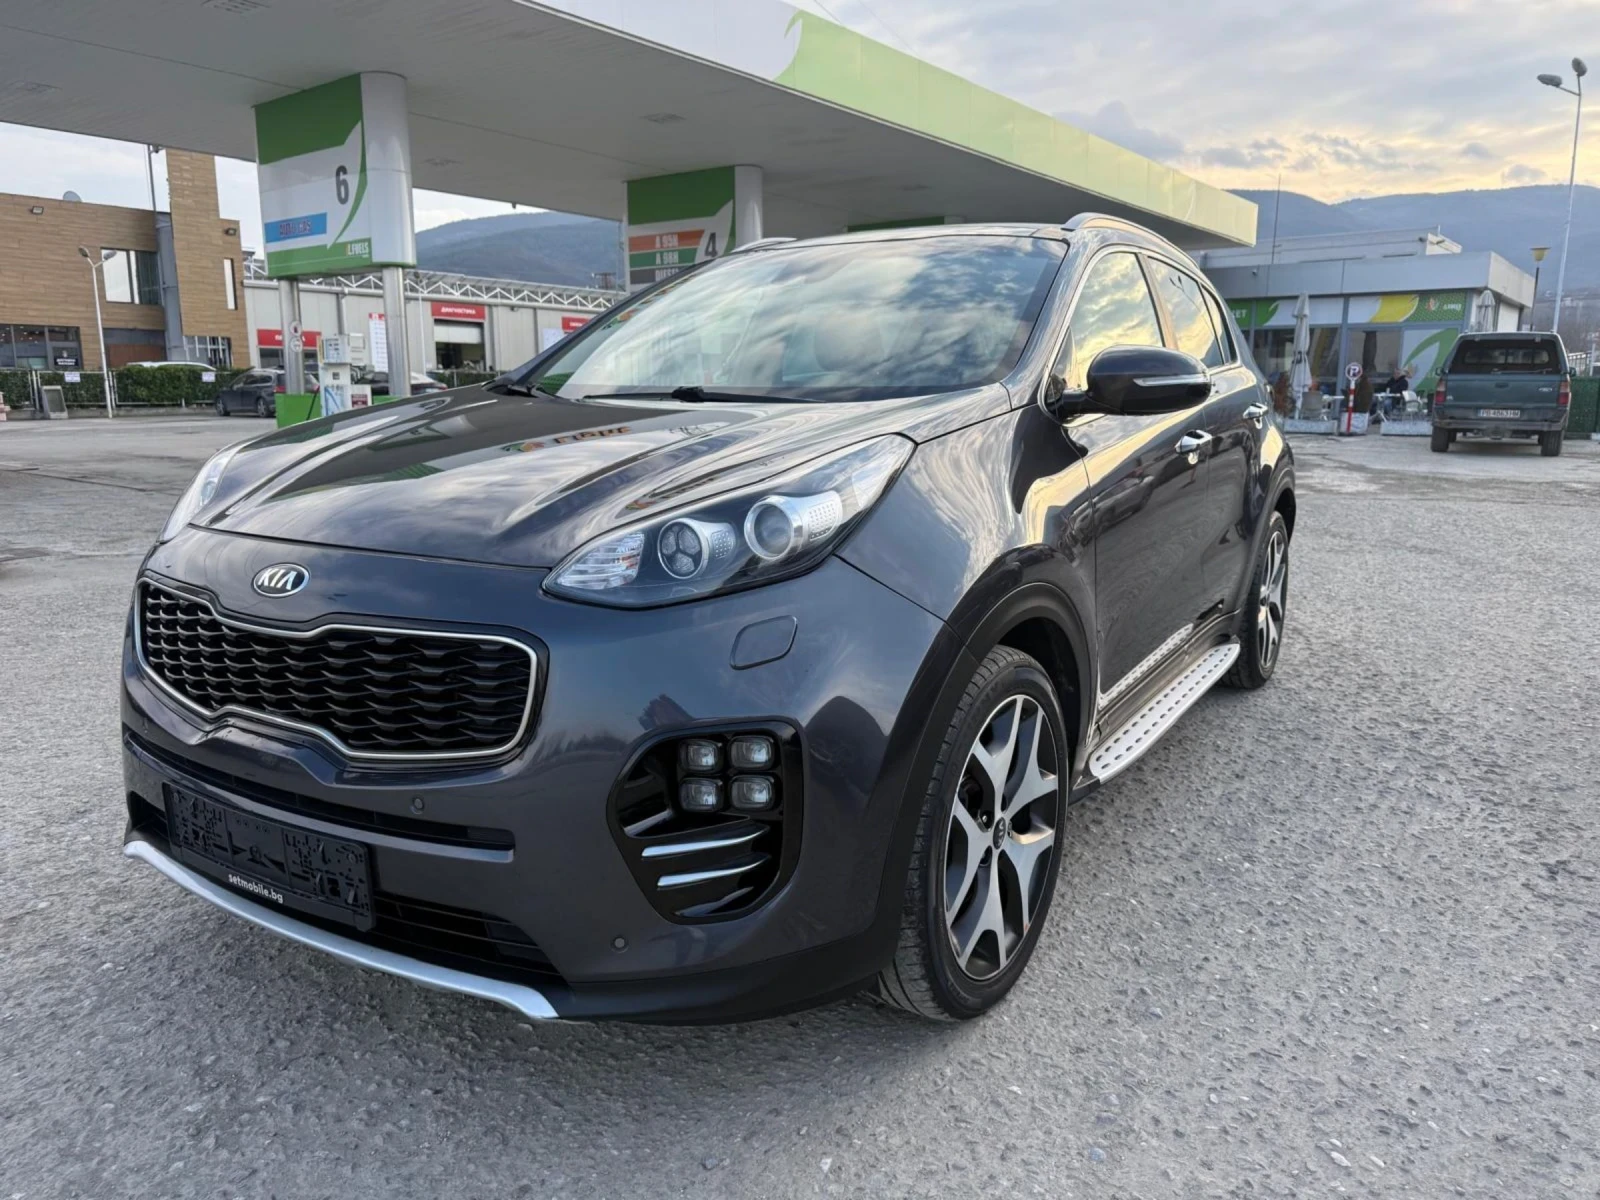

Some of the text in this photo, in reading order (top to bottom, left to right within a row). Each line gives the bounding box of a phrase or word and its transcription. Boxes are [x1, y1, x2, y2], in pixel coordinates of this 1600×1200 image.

[335, 165, 349, 205] 6
[705, 232, 718, 258] 4
[257, 568, 298, 591] KIA
[228, 874, 284, 904] setmobile.bg
